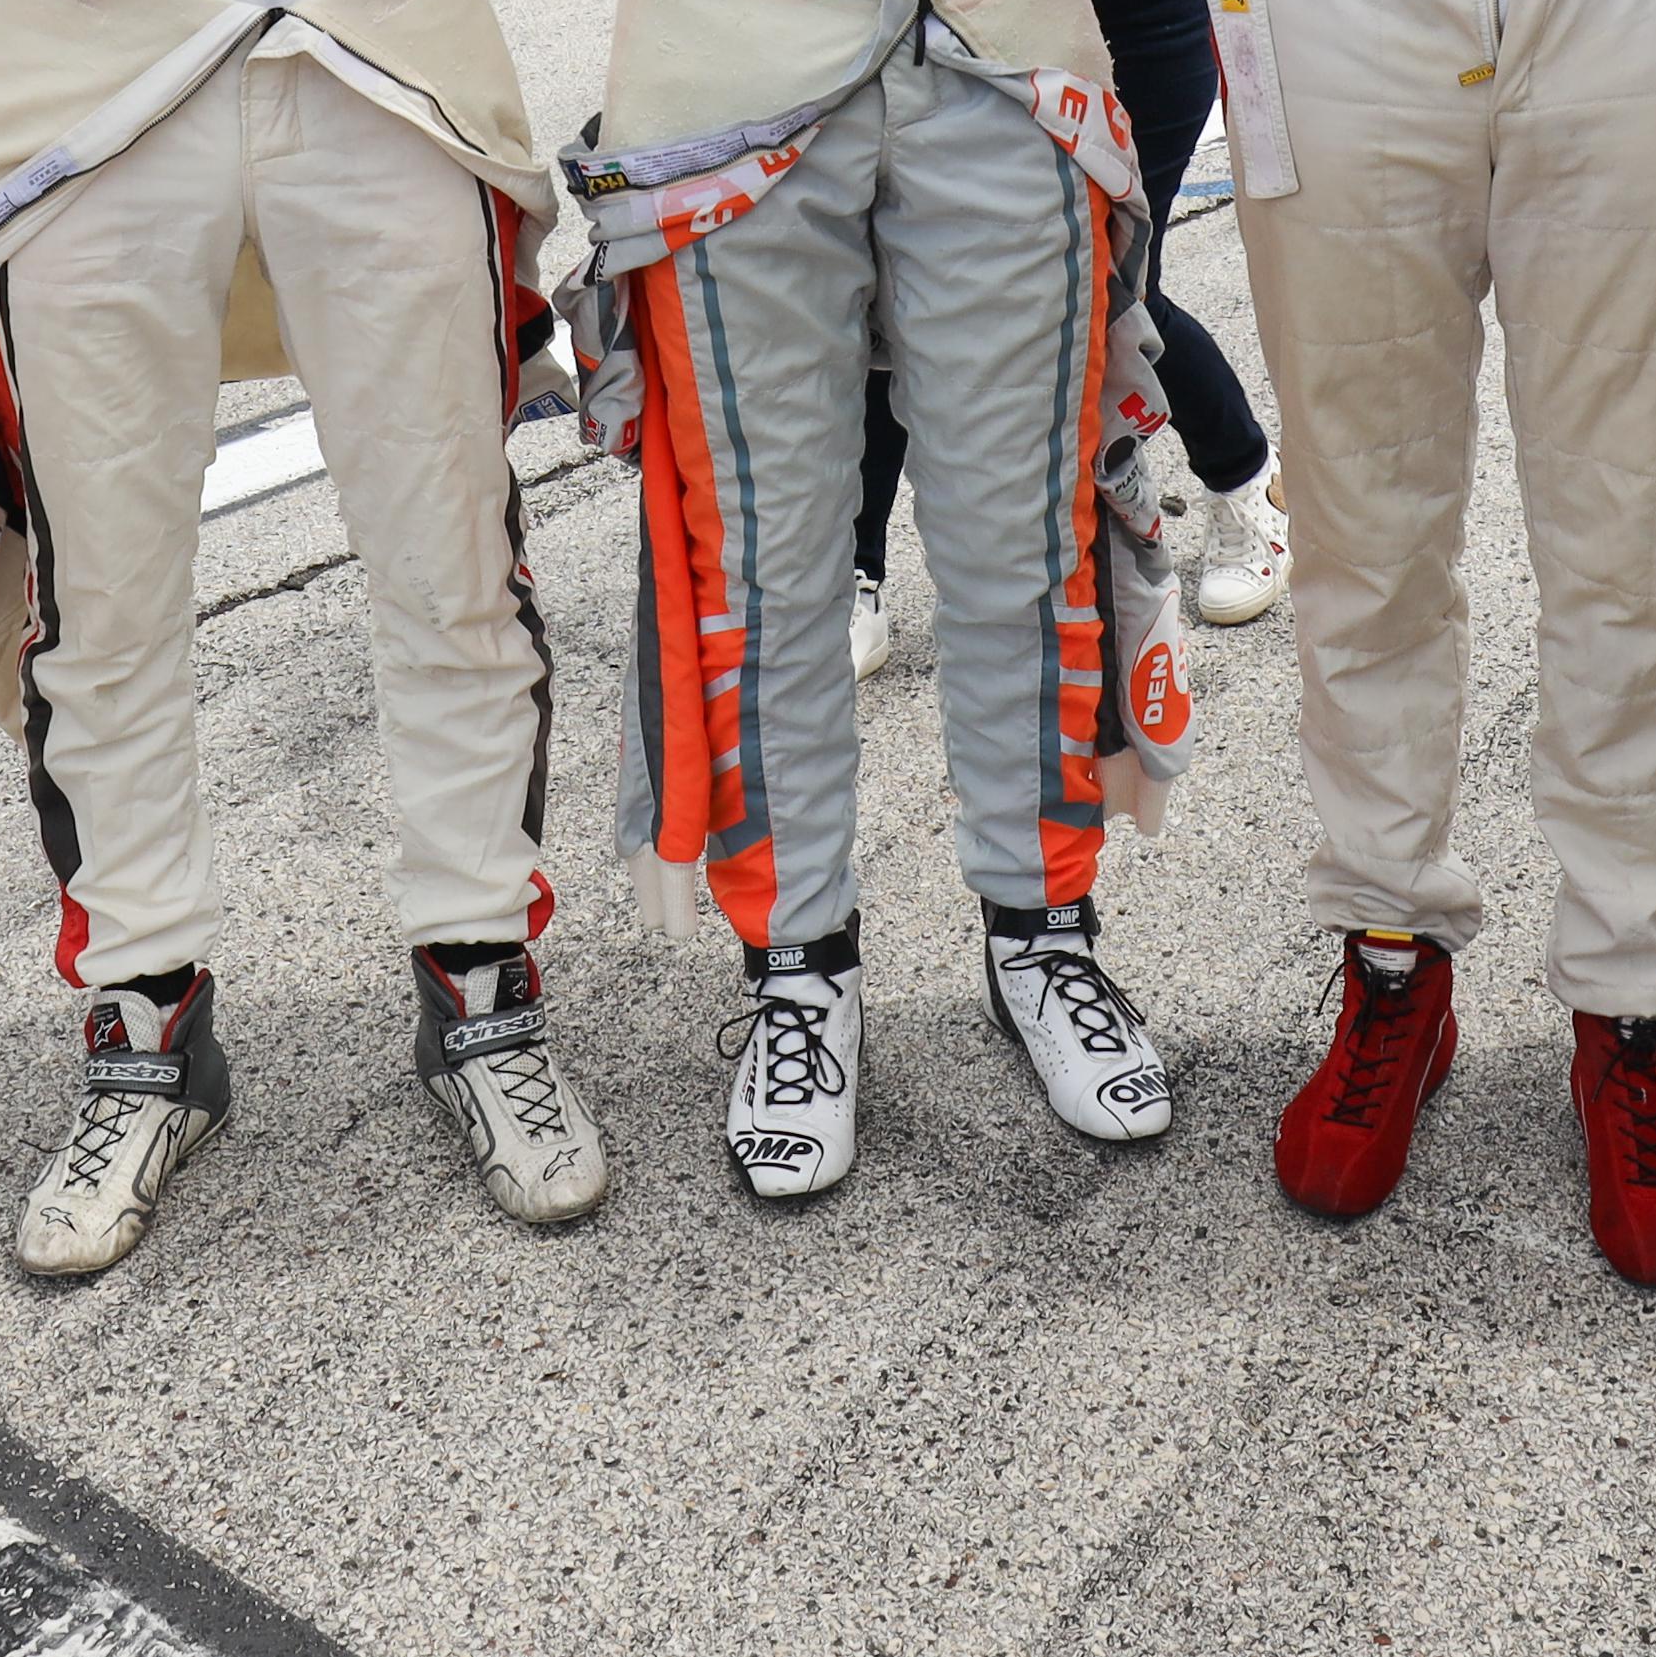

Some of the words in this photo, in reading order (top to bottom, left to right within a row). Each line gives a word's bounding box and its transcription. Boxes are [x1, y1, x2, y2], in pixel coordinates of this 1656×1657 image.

[1046, 910, 1080, 925] OMP
[767, 951, 805, 966] OMP
[733, 1137, 813, 1161] OMP
